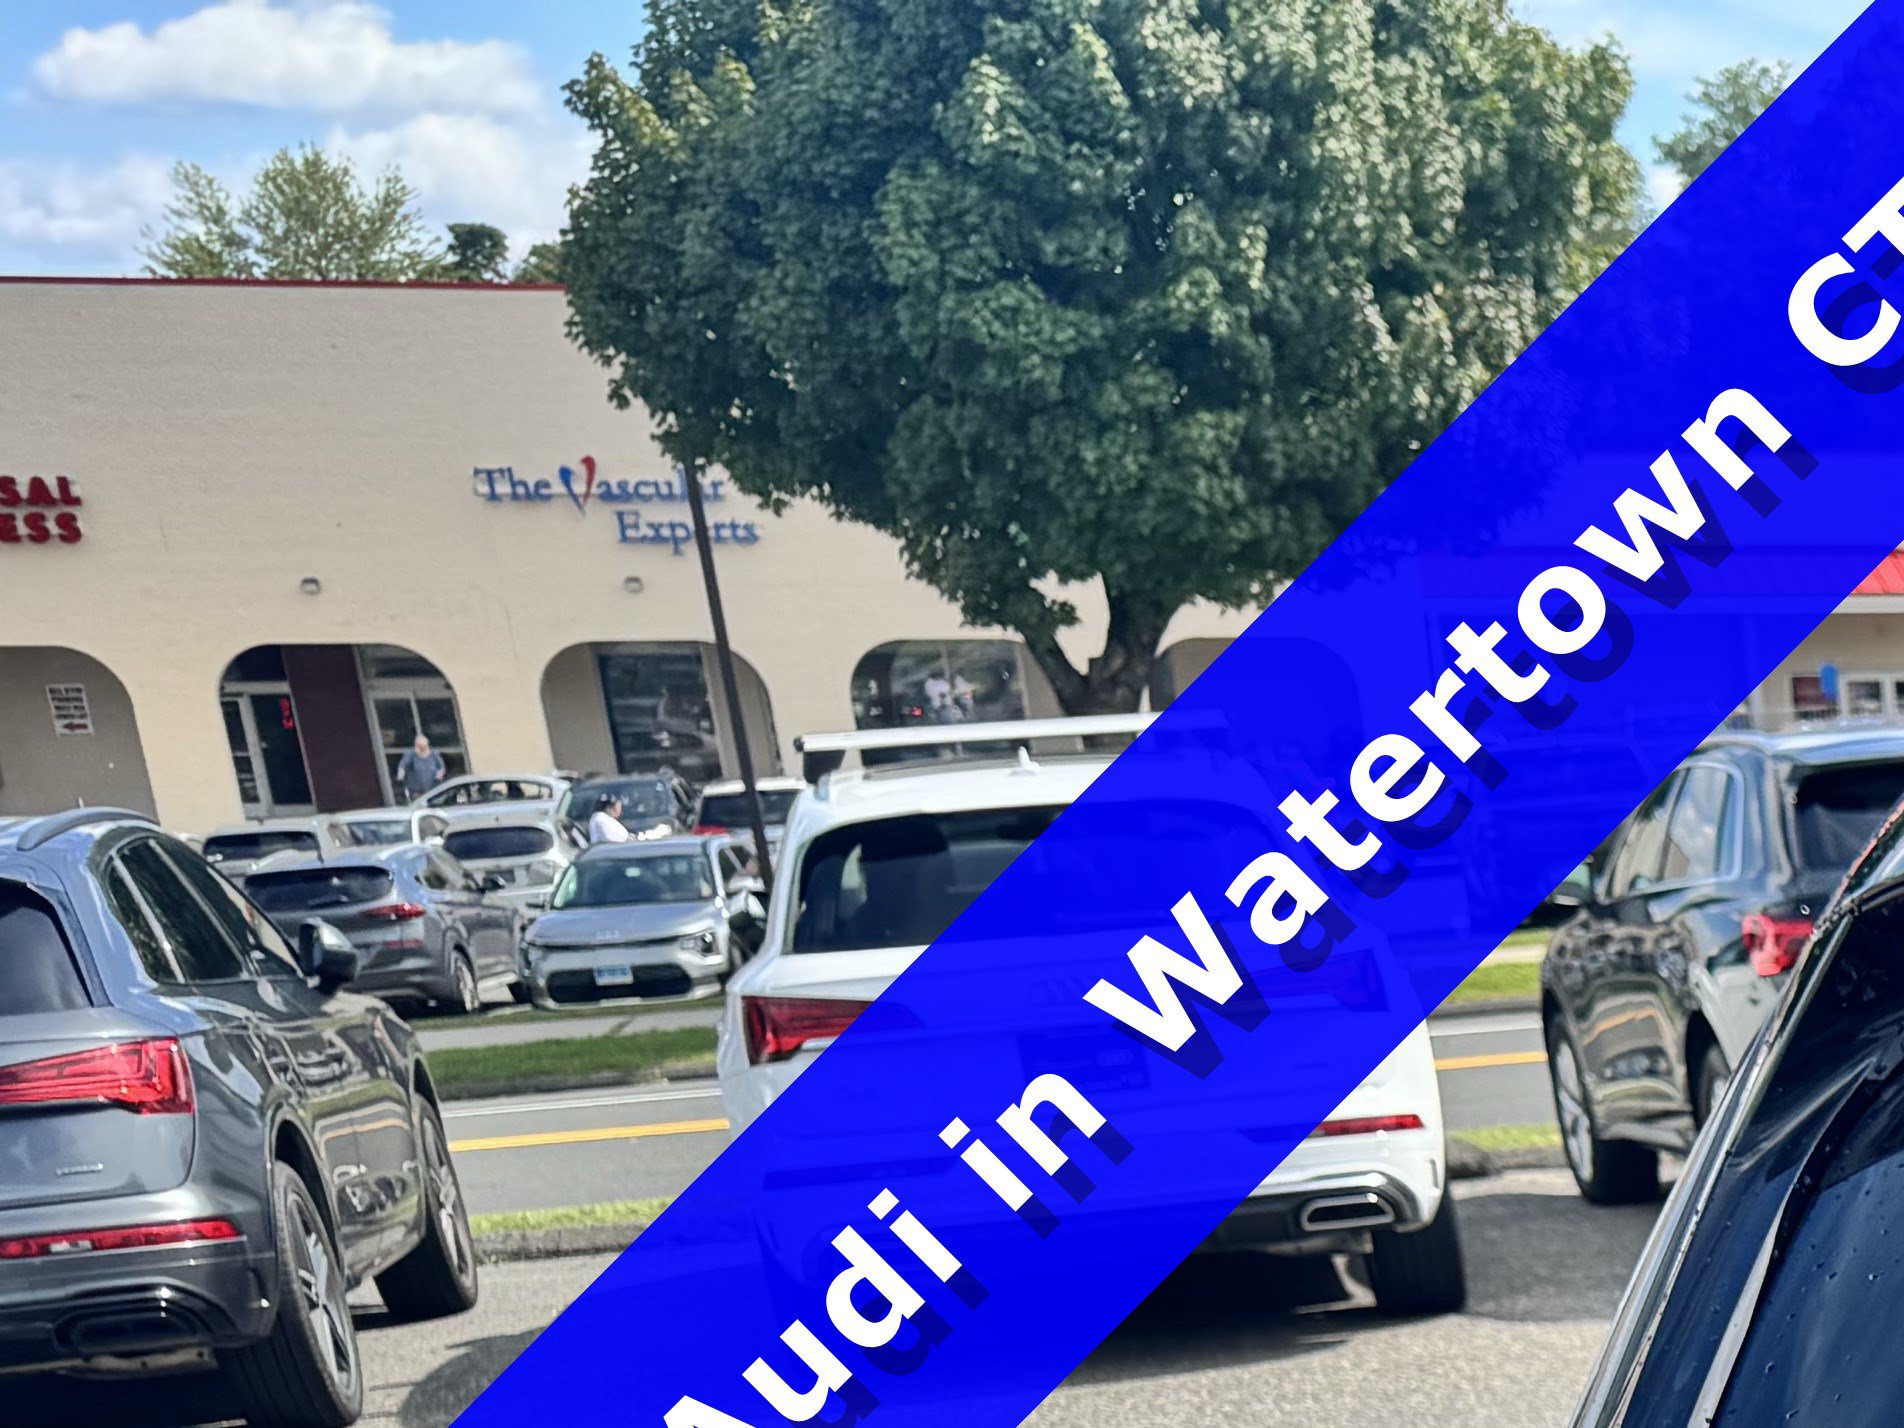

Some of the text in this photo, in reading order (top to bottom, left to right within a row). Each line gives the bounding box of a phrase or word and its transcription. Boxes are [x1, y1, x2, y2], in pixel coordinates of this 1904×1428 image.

[473, 454, 726, 517] The Vasculr
[614, 508, 760, 557] Exprts
